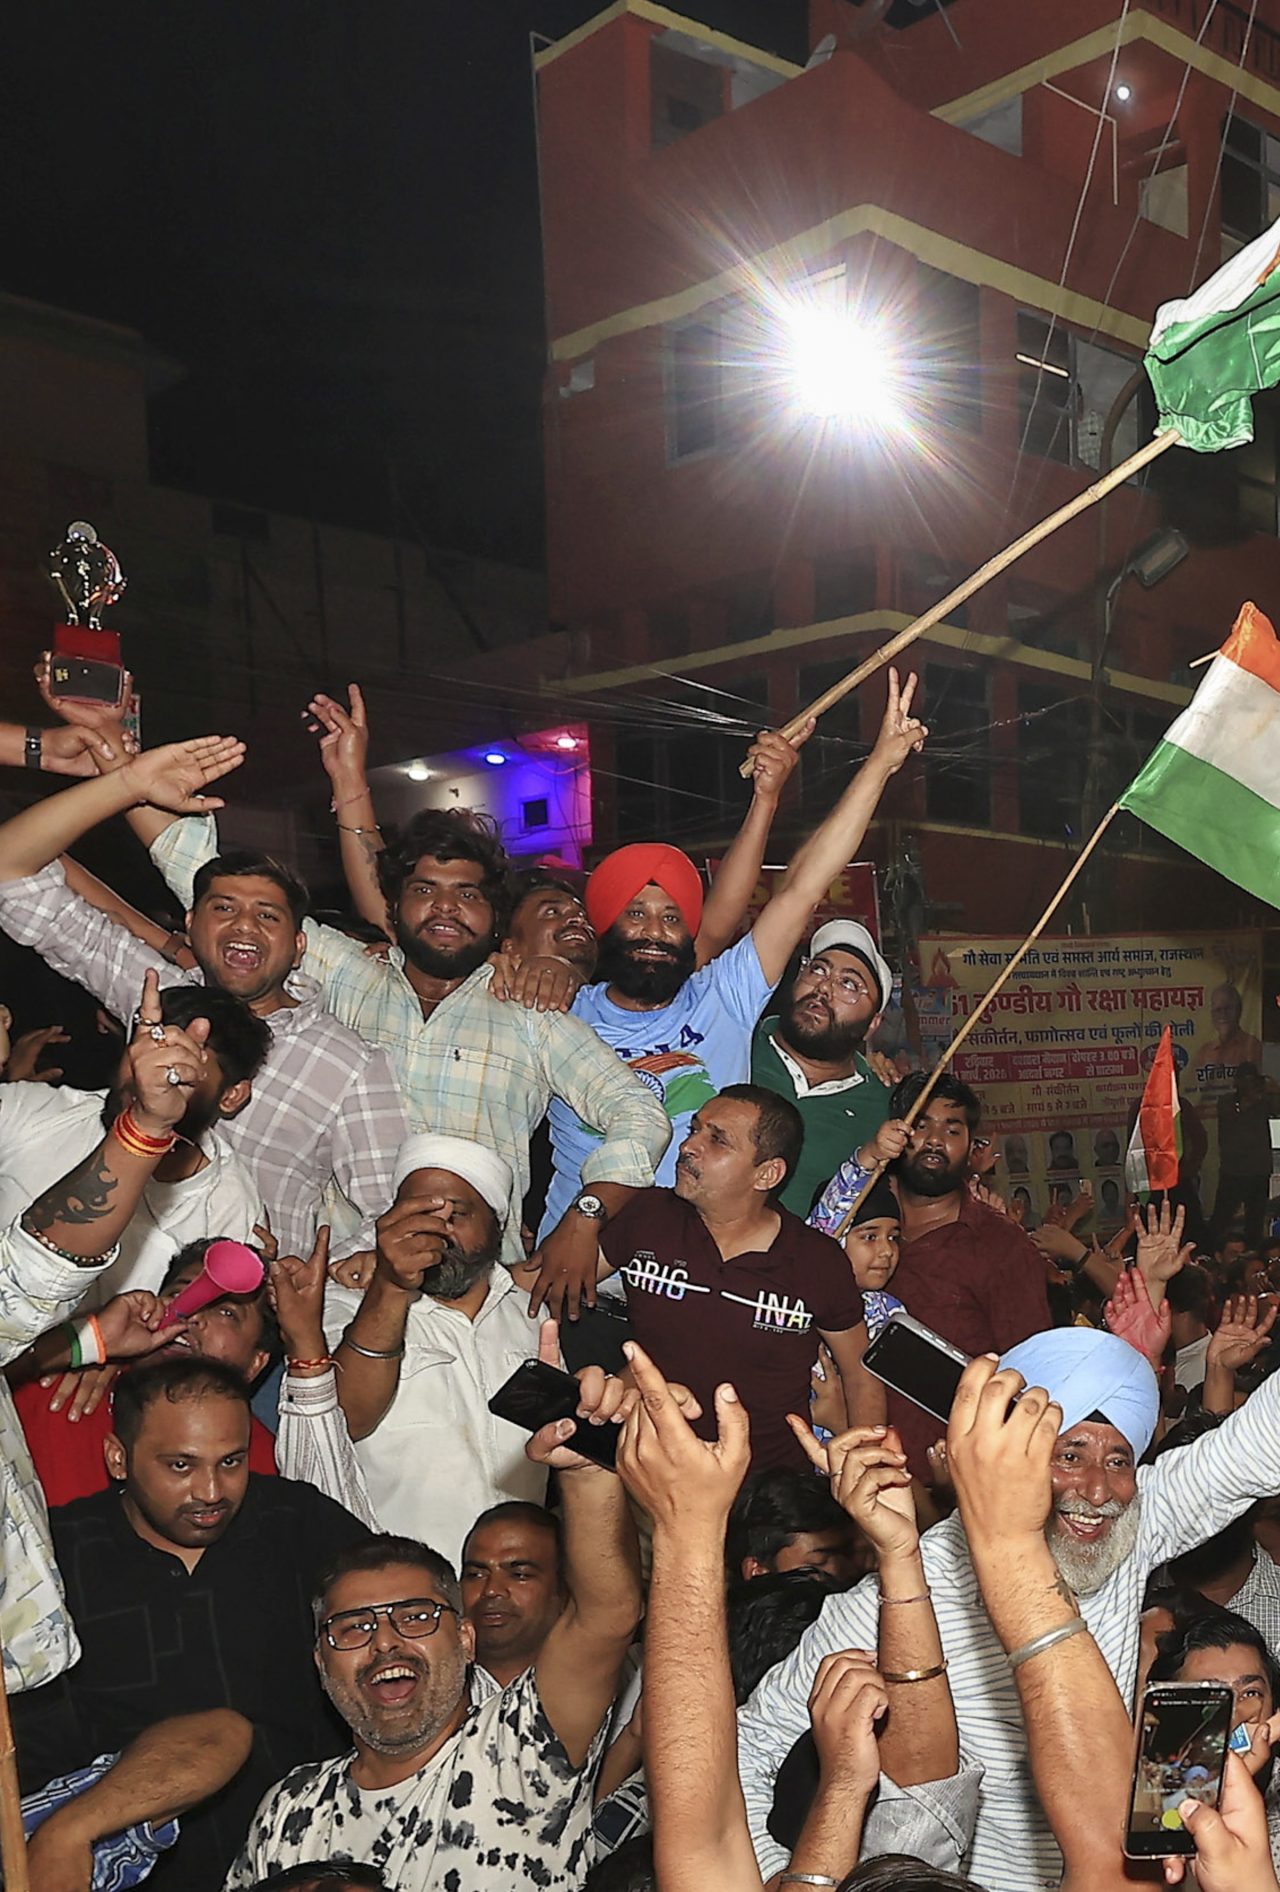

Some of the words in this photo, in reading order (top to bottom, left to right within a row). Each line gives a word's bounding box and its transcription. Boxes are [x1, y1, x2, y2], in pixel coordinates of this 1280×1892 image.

[963, 949, 976, 966] गौ
[979, 949, 1002, 966] सेवा
[1043, 948, 1059, 964] एवं
[1062, 951, 1094, 964] समस्त
[1097, 947, 1120, 963] आर्य
[1123, 949, 1157, 963] समाज,
[1160, 948, 1203, 961] राजस्थान
[973, 984, 1052, 1024] कुण्डीय
[1056, 982, 1081, 1013] गौ
[1086, 988, 1126, 1012] रक्षा
[1131, 986, 1204, 1011] महायज्ञ
[1024, 1025, 1085, 1043] फागोत्सव
[1088, 1024, 1107, 1041] एवं
[1112, 1022, 1141, 1044] फूलों
[1145, 1021, 1161, 1037] की
[1170, 1019, 1194, 1037] ोली
[1120, 1047, 1135, 1060] बजे
[627, 1258, 688, 1300] ORIG
